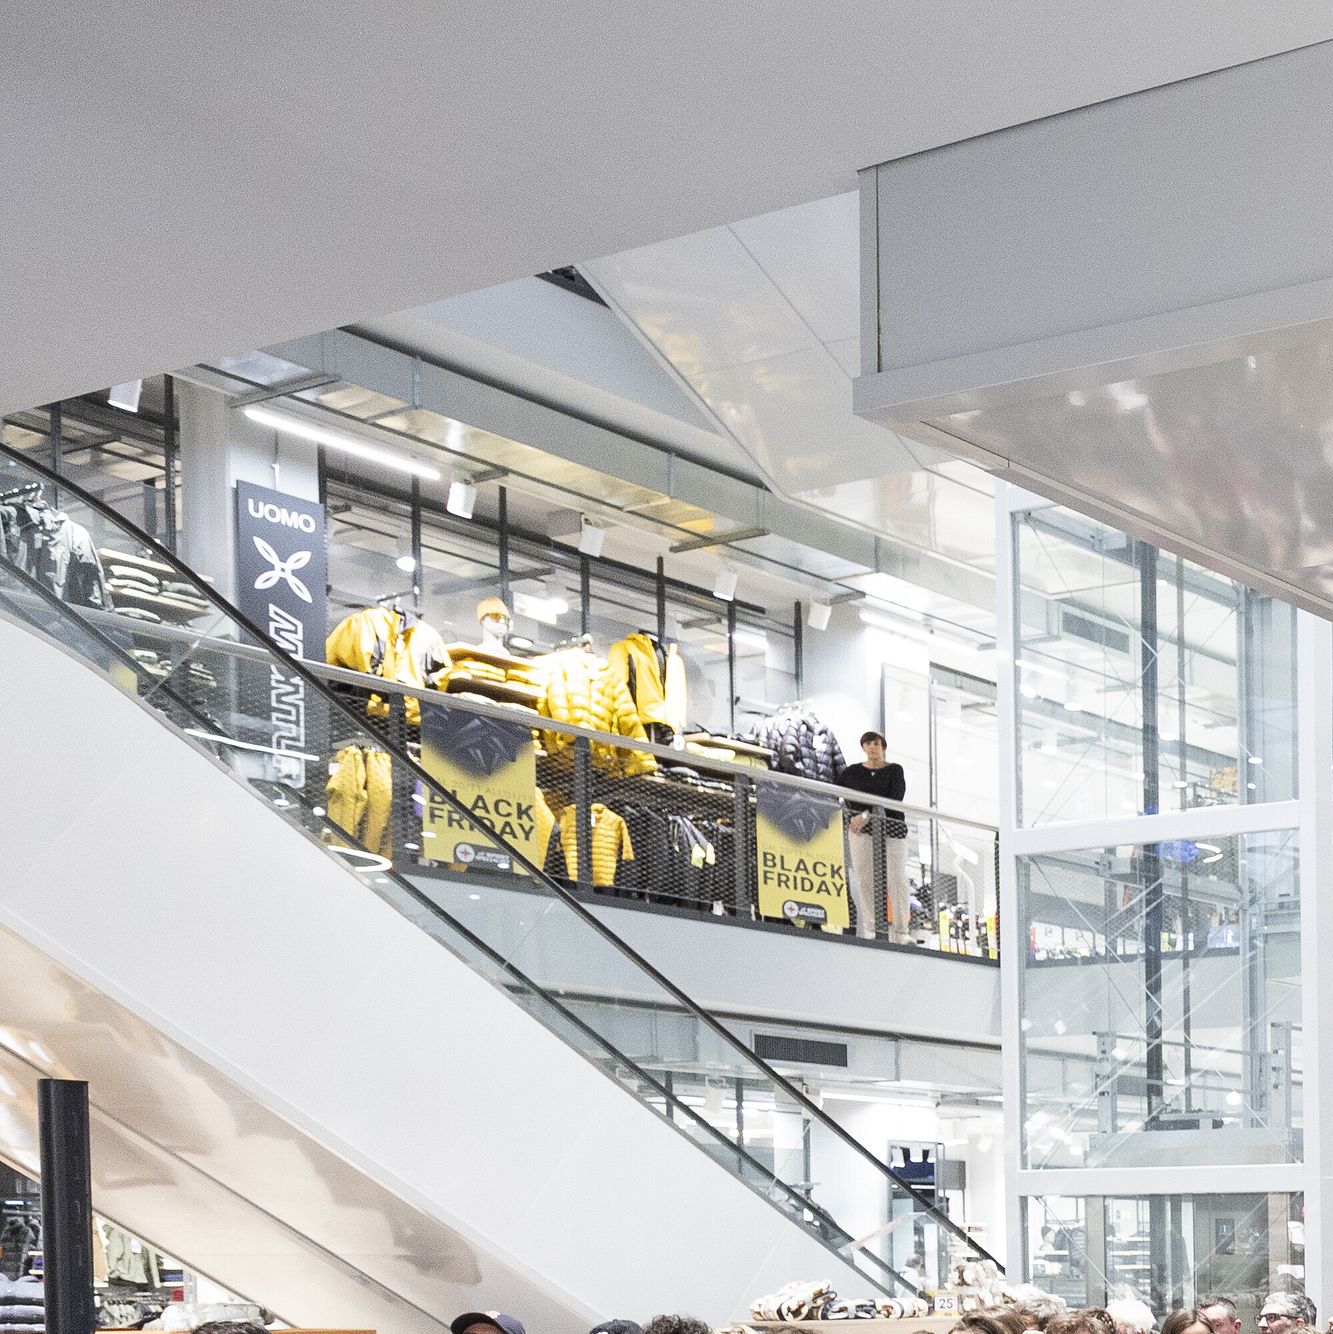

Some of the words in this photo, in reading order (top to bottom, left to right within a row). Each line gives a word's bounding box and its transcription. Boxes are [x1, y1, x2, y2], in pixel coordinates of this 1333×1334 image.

[248, 499, 315, 533] UOMO
[429, 789, 535, 822] BACK
[762, 852, 844, 881] BLACK
[762, 870, 844, 897] FRIDAY
[939, 1298, 953, 1309] 25
